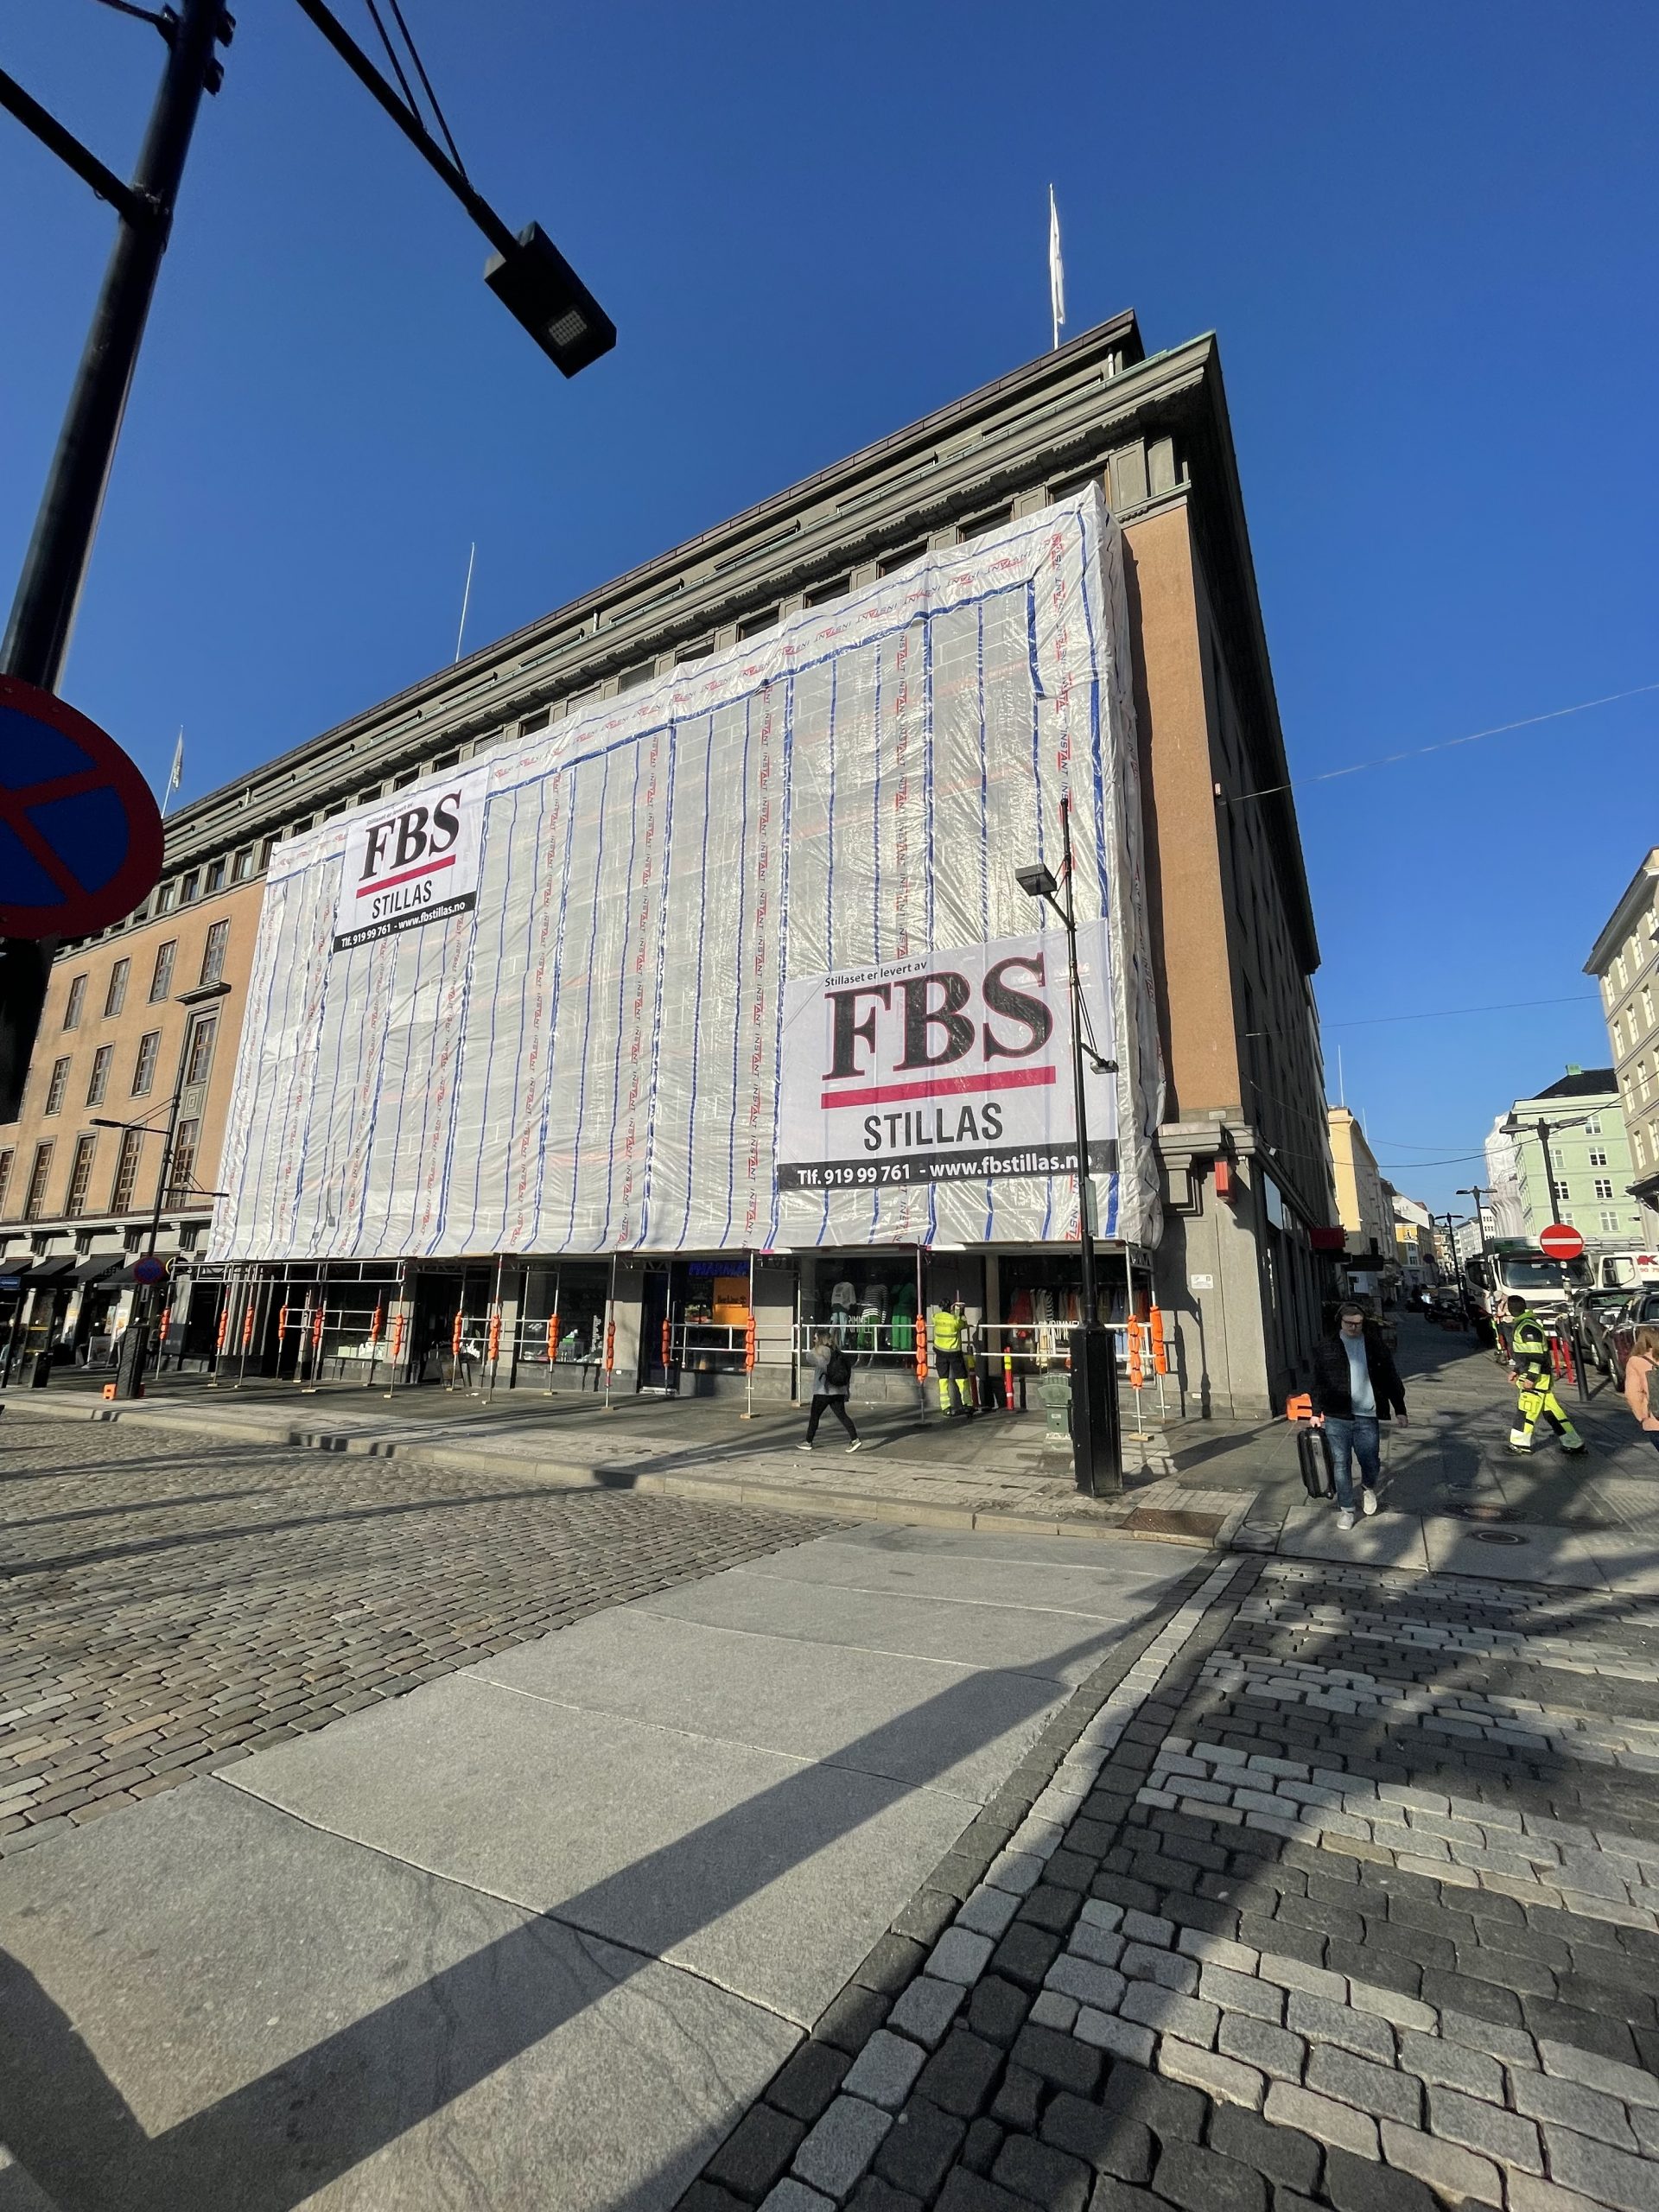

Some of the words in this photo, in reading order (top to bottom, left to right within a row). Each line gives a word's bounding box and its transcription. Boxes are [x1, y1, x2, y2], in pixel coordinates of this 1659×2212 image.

[898, 632, 906, 672] INSTANT
[762, 709, 771, 747] INSTANT
[359, 789, 462, 882] FBS
[760, 797, 768, 836] INSTANT
[758, 842, 767, 882] INSTANT
[372, 880, 432, 919] STILLAS
[756, 887, 766, 930] INSTANT
[341, 938, 353, 948] Tlf.
[353, 932, 366, 944] 919
[366, 929, 377, 940] 99
[378, 923, 391, 937] 761
[398, 901, 466, 930] www.fbstillas.no
[754, 936, 764, 978] INSTANT
[825, 973, 865, 987] Stillaset
[868, 971, 878, 980] er
[880, 963, 912, 977] levert
[914, 961, 927, 970] av
[753, 983, 762, 1028] INSTANT
[822, 951, 1054, 1081] FBS
[752, 1033, 761, 1078] INSTANT
[750, 1083, 760, 1129] INSTANT
[864, 1103, 1003, 1151] STILLAS
[747, 1134, 757, 1182] INSTANT
[798, 1168, 822, 1185] Tlf.
[824, 1167, 854, 1185] 919
[857, 1166, 877, 1183] 99
[880, 1163, 910, 1182] 761
[745, 1188, 756, 1236] INSTANT
